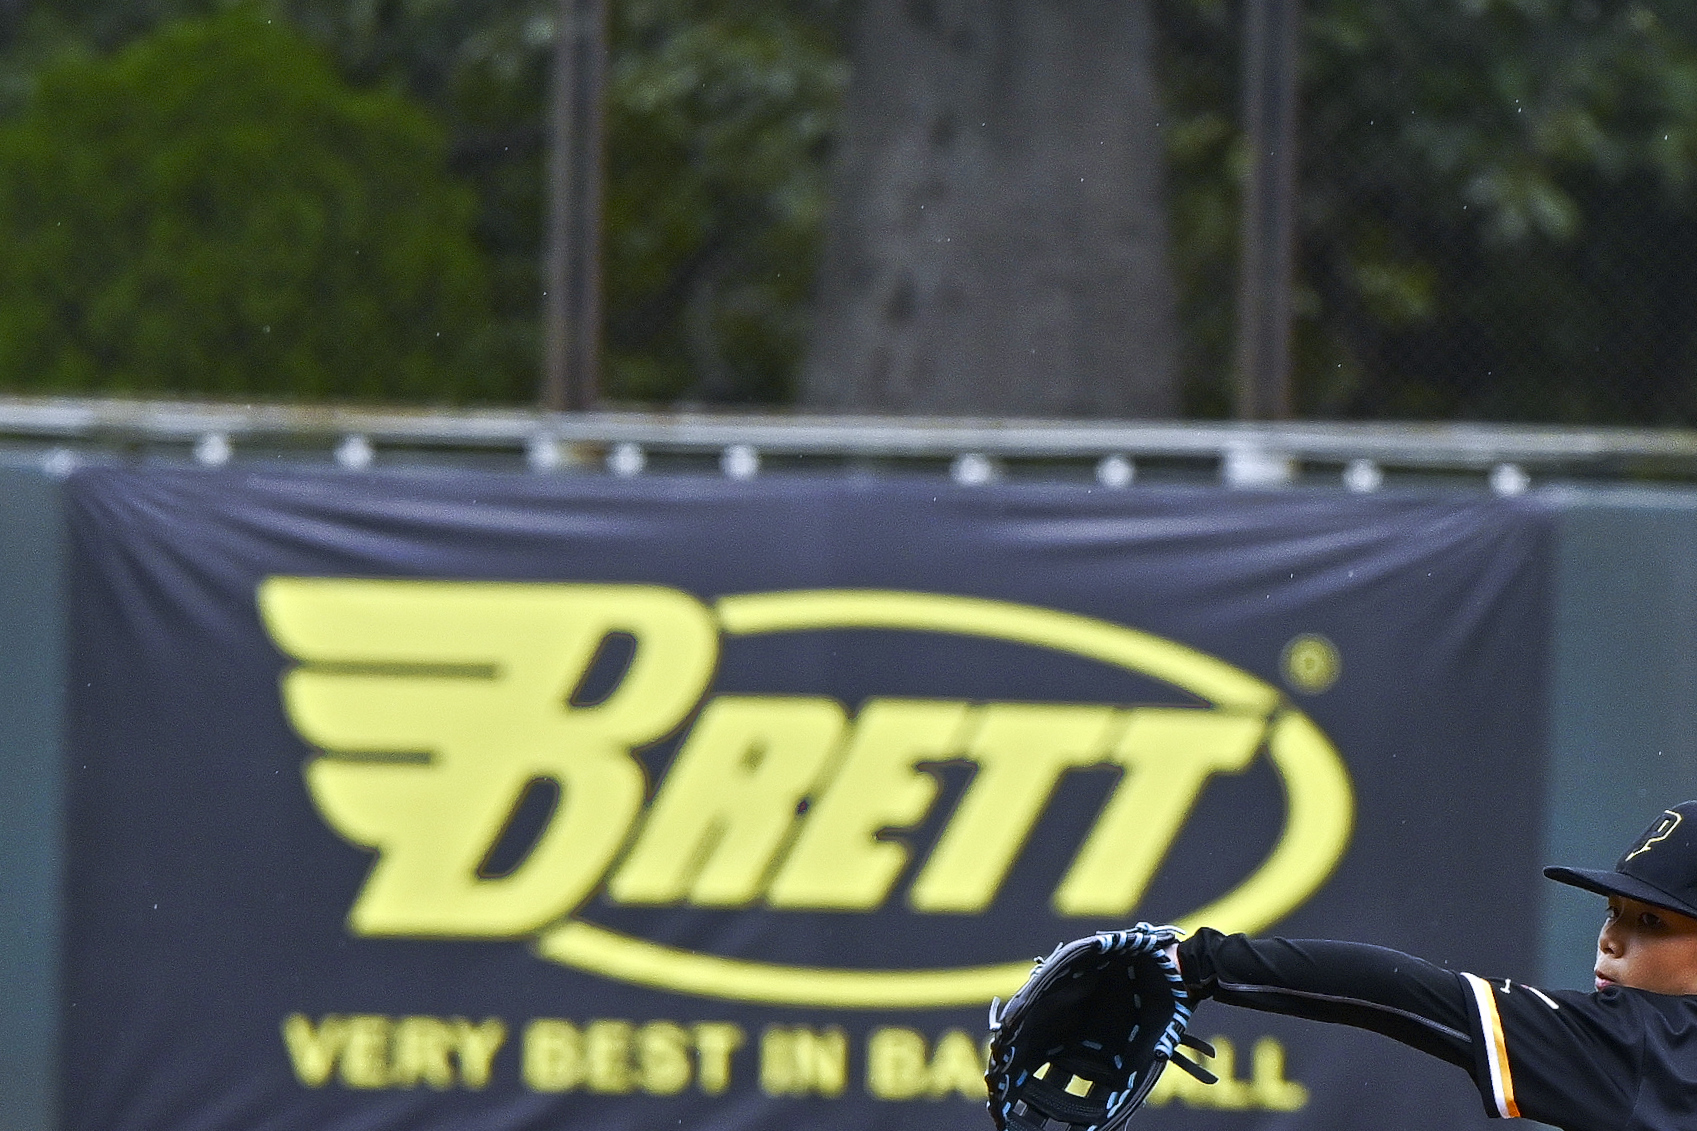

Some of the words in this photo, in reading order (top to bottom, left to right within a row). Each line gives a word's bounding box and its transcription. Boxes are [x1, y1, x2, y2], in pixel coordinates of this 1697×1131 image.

[258, 575, 1268, 935] BRETT
[282, 1013, 505, 1089] VERY
[521, 1017, 744, 1096] BEST
[759, 1025, 849, 1098] IN
[867, 1026, 1309, 1112] BAALL
